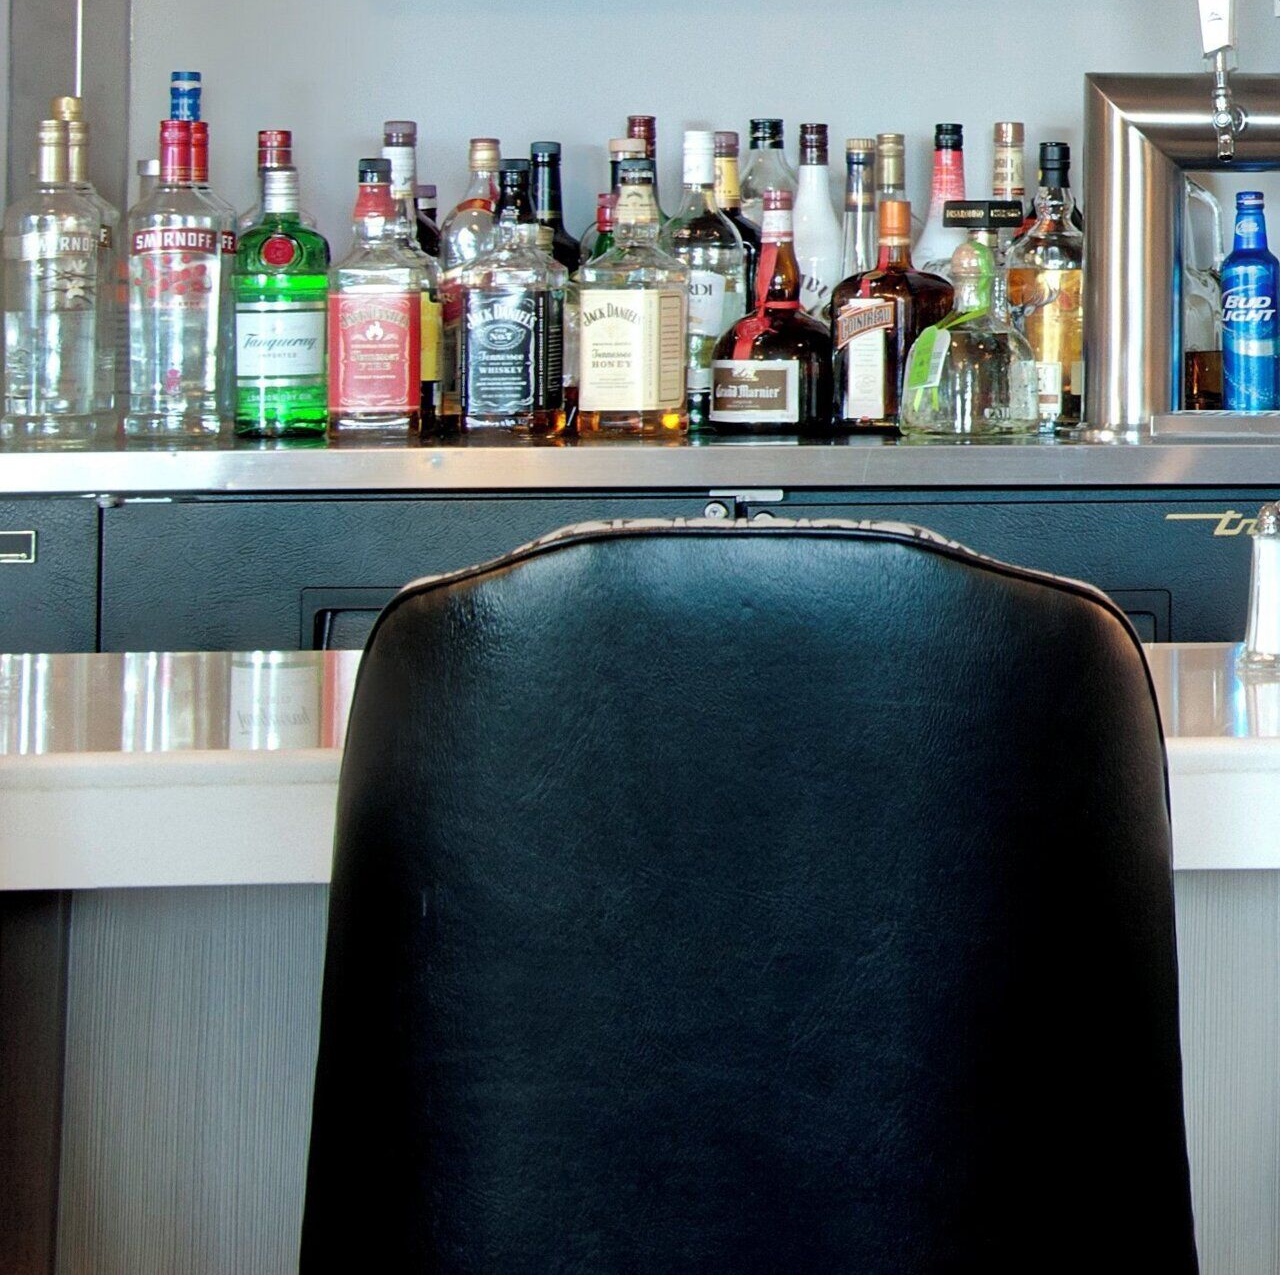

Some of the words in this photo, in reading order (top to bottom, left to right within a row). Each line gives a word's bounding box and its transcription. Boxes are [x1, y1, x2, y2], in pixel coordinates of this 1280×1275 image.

[1225, 296, 1272, 309] BUD
[466, 307, 494, 330] JACK
[583, 308, 607, 327] JACK
[606, 302, 644, 326] DANIEL
[1222, 309, 1276, 322] LIGHT
[841, 307, 891, 341] COINTREAU
[243, 333, 319, 351] Tanqueray
[591, 349, 632, 359] Tennessee
[478, 366, 524, 374] WHISKEY
[591, 361, 632, 369] HONEY
[738, 384, 782, 399] Marnier
